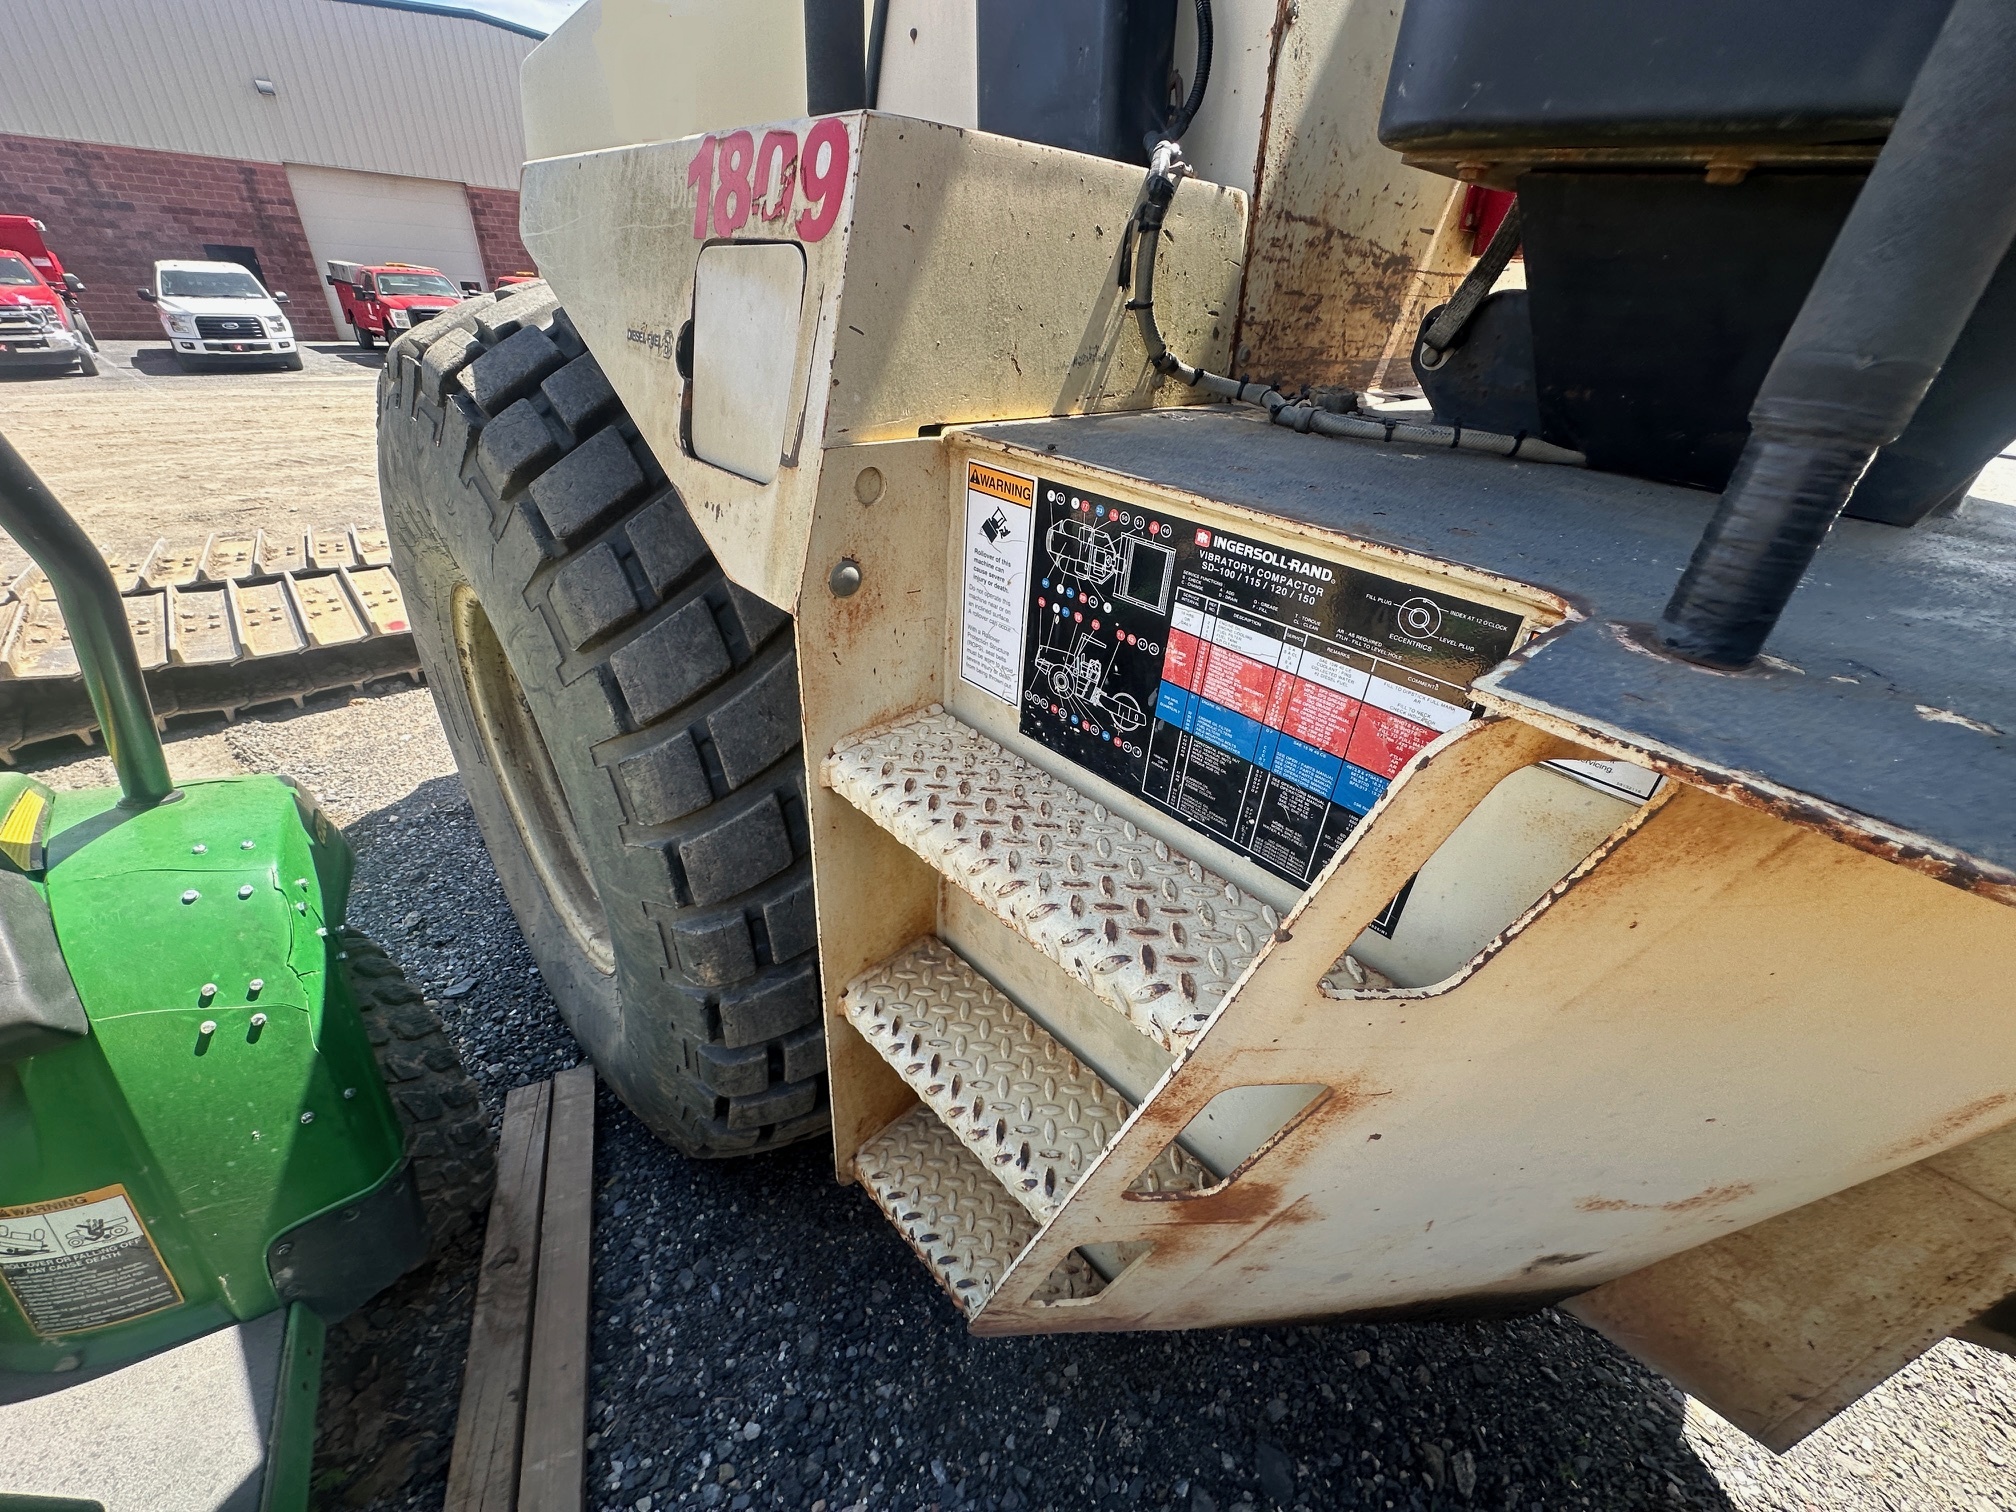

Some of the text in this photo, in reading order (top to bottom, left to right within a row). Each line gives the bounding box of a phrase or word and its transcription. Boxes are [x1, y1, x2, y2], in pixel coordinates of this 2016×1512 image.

[688, 118, 850, 243] 1809
[979, 473, 1031, 500] WARNING
[974, 547, 994, 561] Rollover
[1212, 534, 1333, 583] INGERSOLL-RAND
[974, 556, 994, 569] machine
[988, 572, 1004, 583] severe
[1183, 569, 1199, 579] SERVICE
[1198, 548, 1324, 597] VIBRATORY COMPACTOR
[1186, 581, 1203, 590] CHANGE
[1188, 576, 1202, 584] CHECK
[1183, 592, 1199, 601] SERVICE
[1244, 574, 1261, 588] 115
[1270, 583, 1287, 596] 120
[1297, 592, 1315, 606] 150
[1181, 596, 1199, 606] INTERVAL
[1224, 594, 1237, 603] DRAIN
[1377, 597, 1392, 605] PLUG
[1260, 601, 1278, 611] GREASE
[1233, 612, 1261, 627] DESCRIPTION
[1301, 615, 1321, 626] TORQUE
[1450, 609, 1466, 619] INDEX
[1302, 622, 1318, 631] CLEAN
[1286, 632, 1303, 642] SERVICE
[1356, 634, 1382, 647] REQUIRED
[1388, 632, 1432, 652] ECCENTRICS
[1335, 633, 1348, 641] FTLH
[1366, 644, 1386, 655] LEVEL
[1387, 651, 1402, 660] HOLE
[1439, 636, 1474, 652] LEVEL PLUG
[1326, 646, 1350, 659] REMARKS
[1311, 665, 1354, 684] COLLECTED WATER
[1319, 673, 1335, 682] DIESEL
[1407, 675, 1438, 691] COMMENTS
[1403, 689, 1426, 701] DIPSTICK
[1440, 702, 1456, 712] MARK
[1389, 705, 1404, 714] CHECK
[1578, 760, 1613, 774] ervicing.
[13, 1196, 87, 1216] WARNING
[2, 1238, 142, 1270] ROLLOVER OR FALLING OFF
[27, 1252, 121, 1274] MAY CAUSE DEATH
